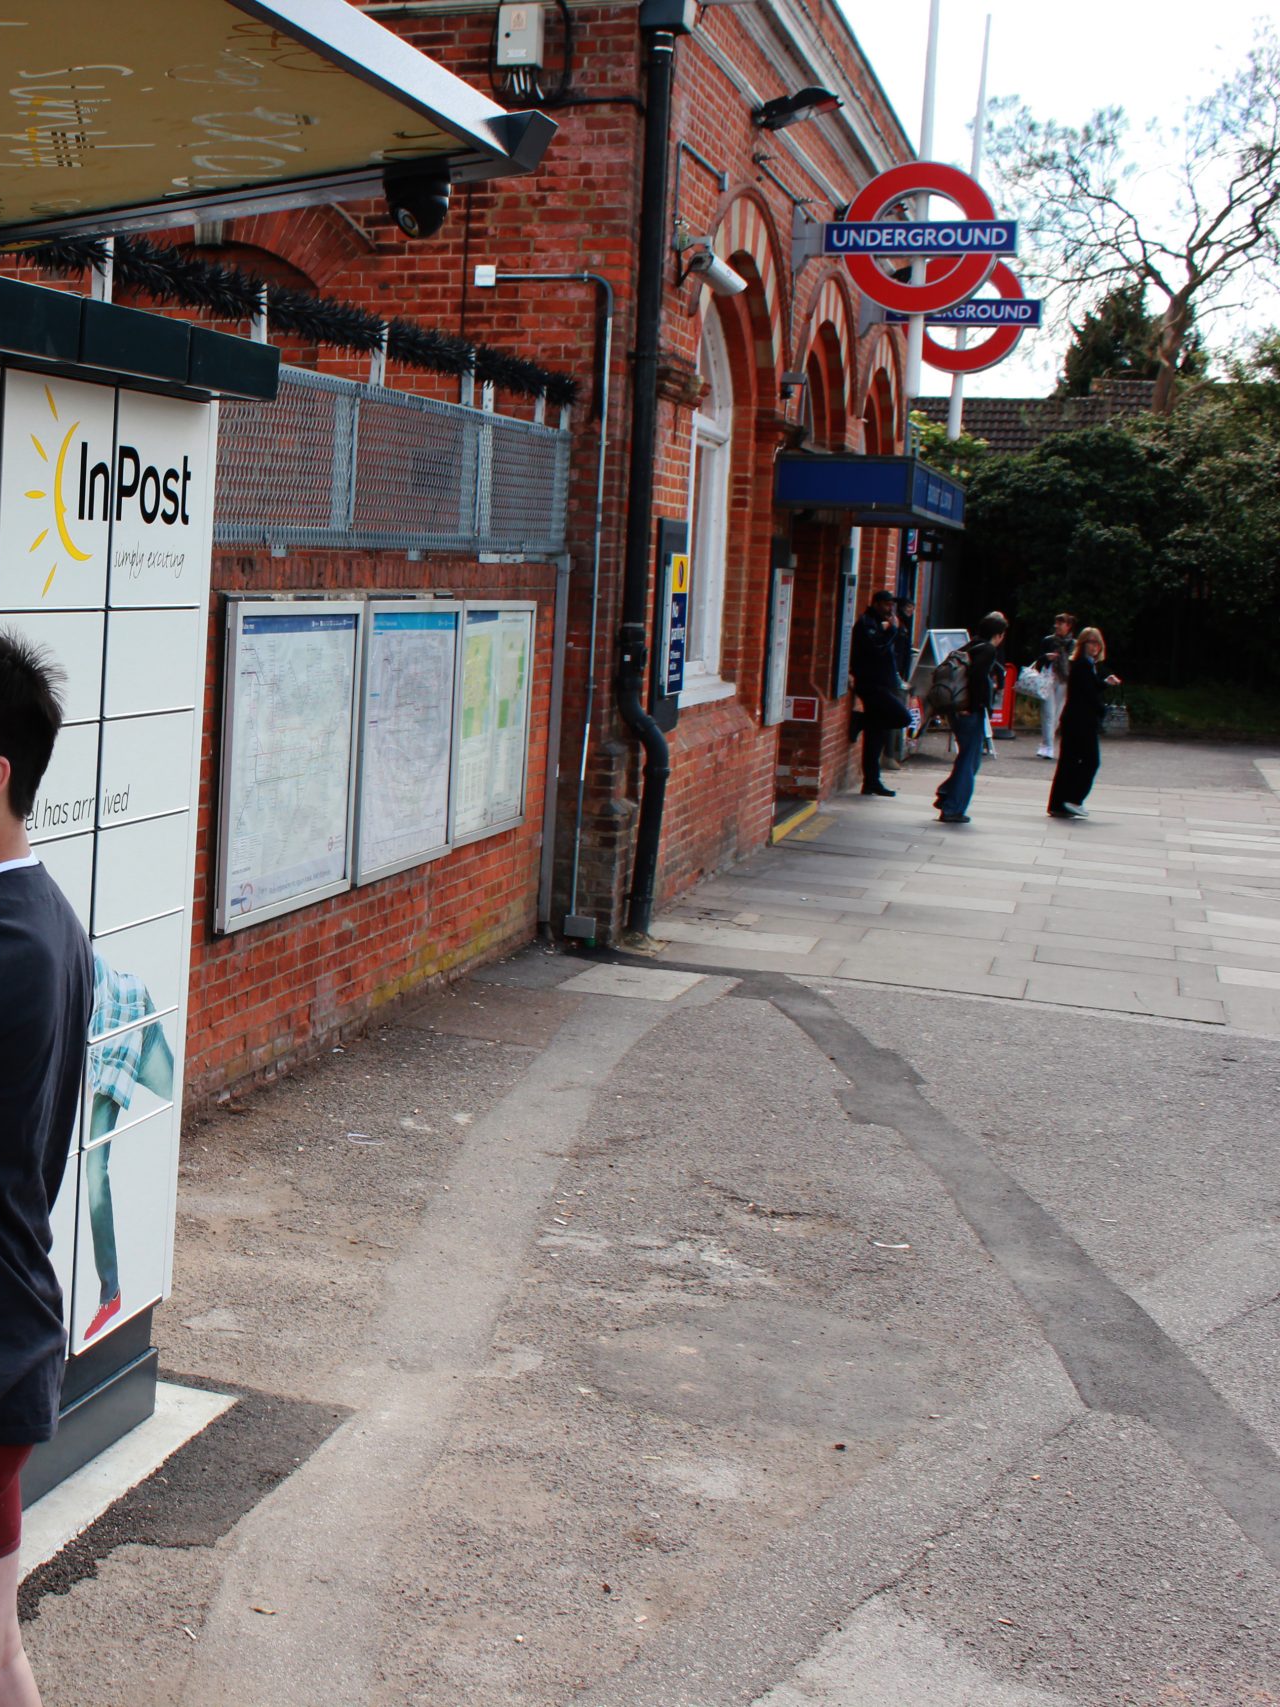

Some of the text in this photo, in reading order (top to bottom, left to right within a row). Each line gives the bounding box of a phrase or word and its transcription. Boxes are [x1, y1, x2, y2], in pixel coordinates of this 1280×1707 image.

[832, 227, 1008, 247] UNDERGROUND
[77, 441, 192, 526] InPost
[114, 540, 185, 580] simply exciting
[42, 798, 69, 828] has
[72, 784, 131, 822] arrived
